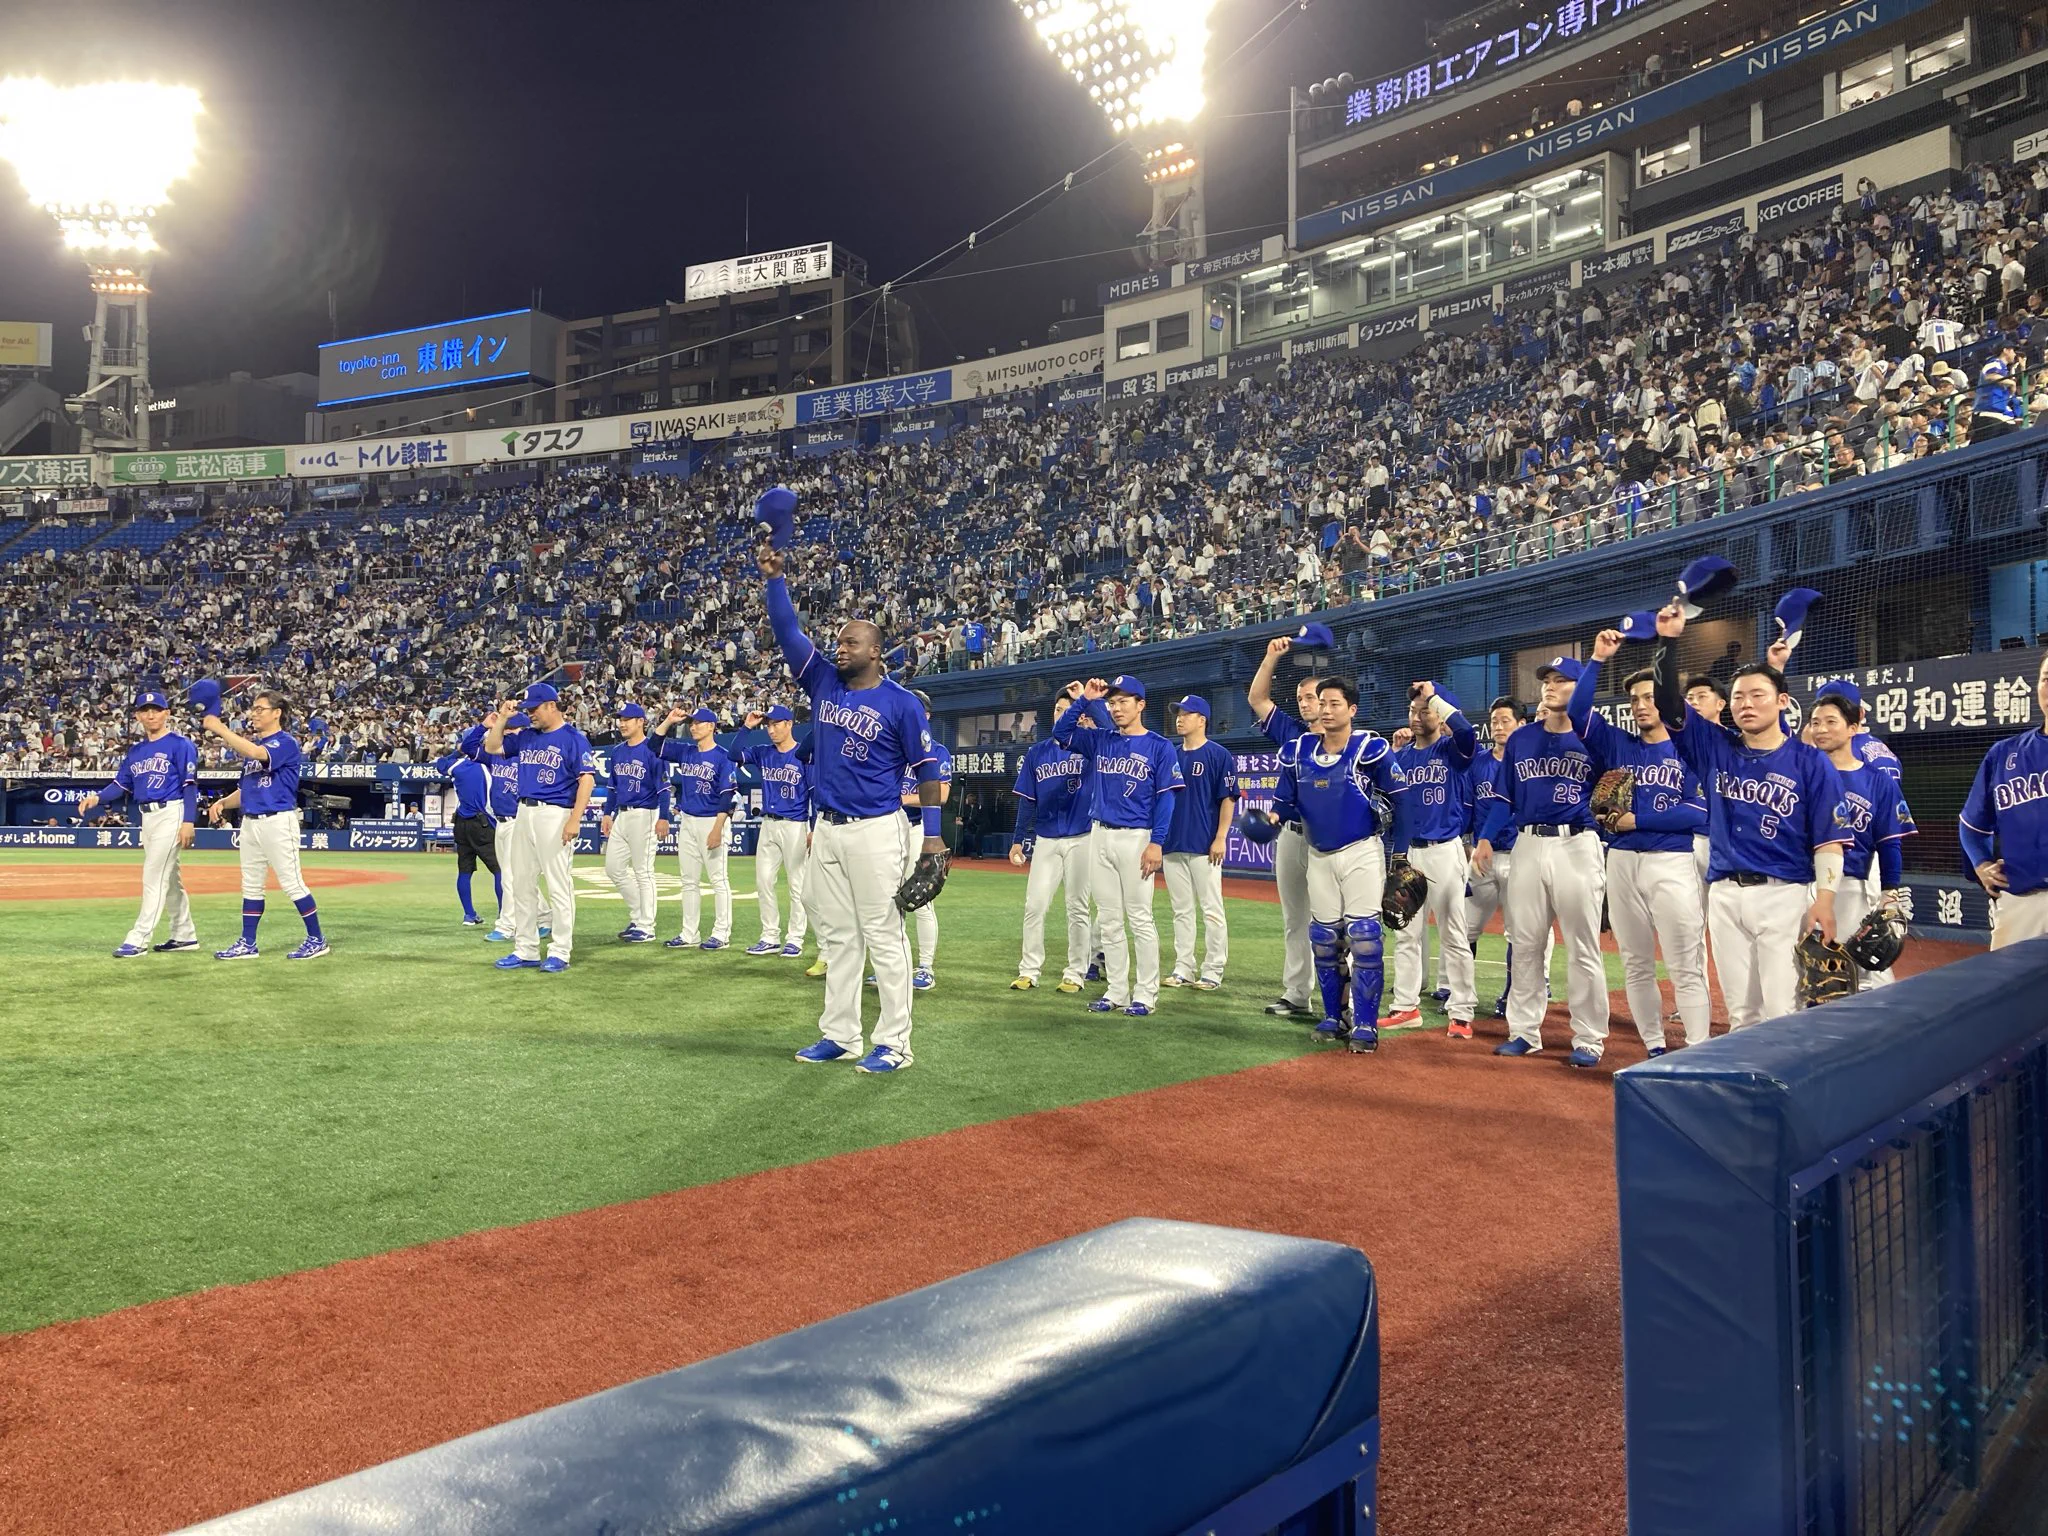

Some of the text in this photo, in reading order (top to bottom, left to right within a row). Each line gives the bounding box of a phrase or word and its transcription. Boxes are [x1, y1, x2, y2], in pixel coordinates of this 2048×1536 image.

[1747, 3, 1878, 76] NISSAN
[1527, 106, 1636, 162] NISSAN
[1341, 182, 1435, 225] NISSAN
[1762, 186, 1842, 223] KEY COFFEE
[753, 253, 828, 282] 大関商事
[1202, 247, 1261, 274] 帝京平成大学
[1583, 251, 1631, 280] 辻・本郷
[1110, 274, 1159, 299] MORE'S
[1504, 278, 1571, 304] メディカルケアシステム
[1430, 294, 1492, 321] FMヨコハマ
[1375, 314, 1418, 337] シンメイ
[417, 335, 508, 374] 東横イン
[1291, 331, 1349, 357] 神奈川新聞
[338, 352, 400, 375] toyoko-inn
[380, 364, 407, 380] com
[986, 356, 1065, 382] MITSUMOTO
[1229, 351, 1280, 369] テレビ神奈川
[811, 376, 936, 419] 産業能率大学
[1123, 374, 1156, 398] 照宝
[157, 398, 176, 411] Hotel
[727, 409, 768, 424] 岩崎電気
[655, 413, 725, 438] IWASAKI
[522, 427, 584, 455] タスク
[175, 452, 267, 478] 武松商事
[358, 439, 448, 468] トイレ診断士
[519, 749, 563, 770] DRAGONS
[841, 737, 868, 761] 23
[330, 764, 377, 778] 全国保証
[1097, 755, 1151, 781] DRAGONS
[1192, 761, 1205, 776] D
[1232, 755, 1280, 772] 海セミナ
[1515, 757, 1592, 783] DRAGONS
[2005, 753, 2018, 771] C
[146, 775, 166, 789] 77
[537, 768, 556, 784] 89
[696, 781, 711, 795] 72
[761, 766, 802, 786] DRAGONS
[780, 785, 796, 800] 81
[1123, 780, 1137, 797] 7
[1422, 786, 1445, 806] 60
[1553, 783, 1582, 804] 25
[1716, 769, 1800, 818] DRAGONS
[97, 831, 144, 846] 津久
[1760, 814, 1780, 840] 5
[357, 836, 418, 848] インタープラン
